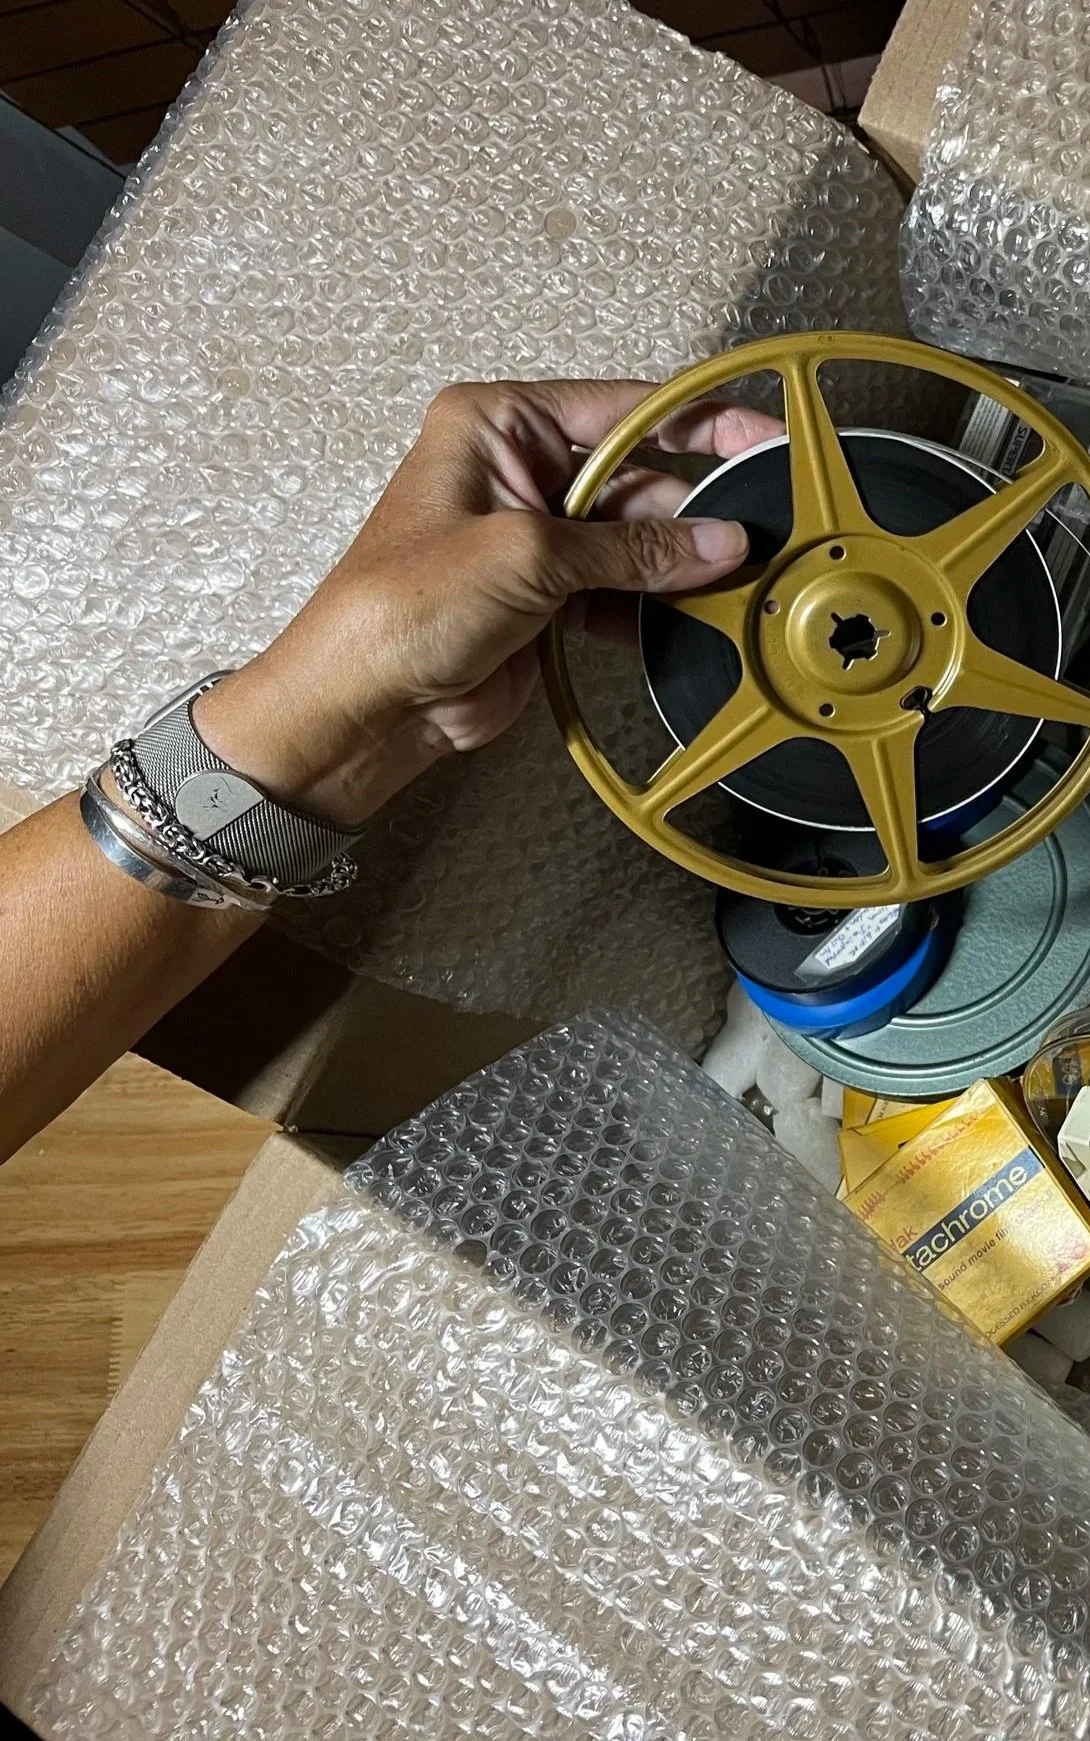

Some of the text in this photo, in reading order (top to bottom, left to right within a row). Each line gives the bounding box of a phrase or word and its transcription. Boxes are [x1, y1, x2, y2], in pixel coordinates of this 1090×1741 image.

[905, 1165, 1028, 1271] tachrome
[938, 1261, 967, 1290] sound
[968, 1239, 996, 1266] movie
